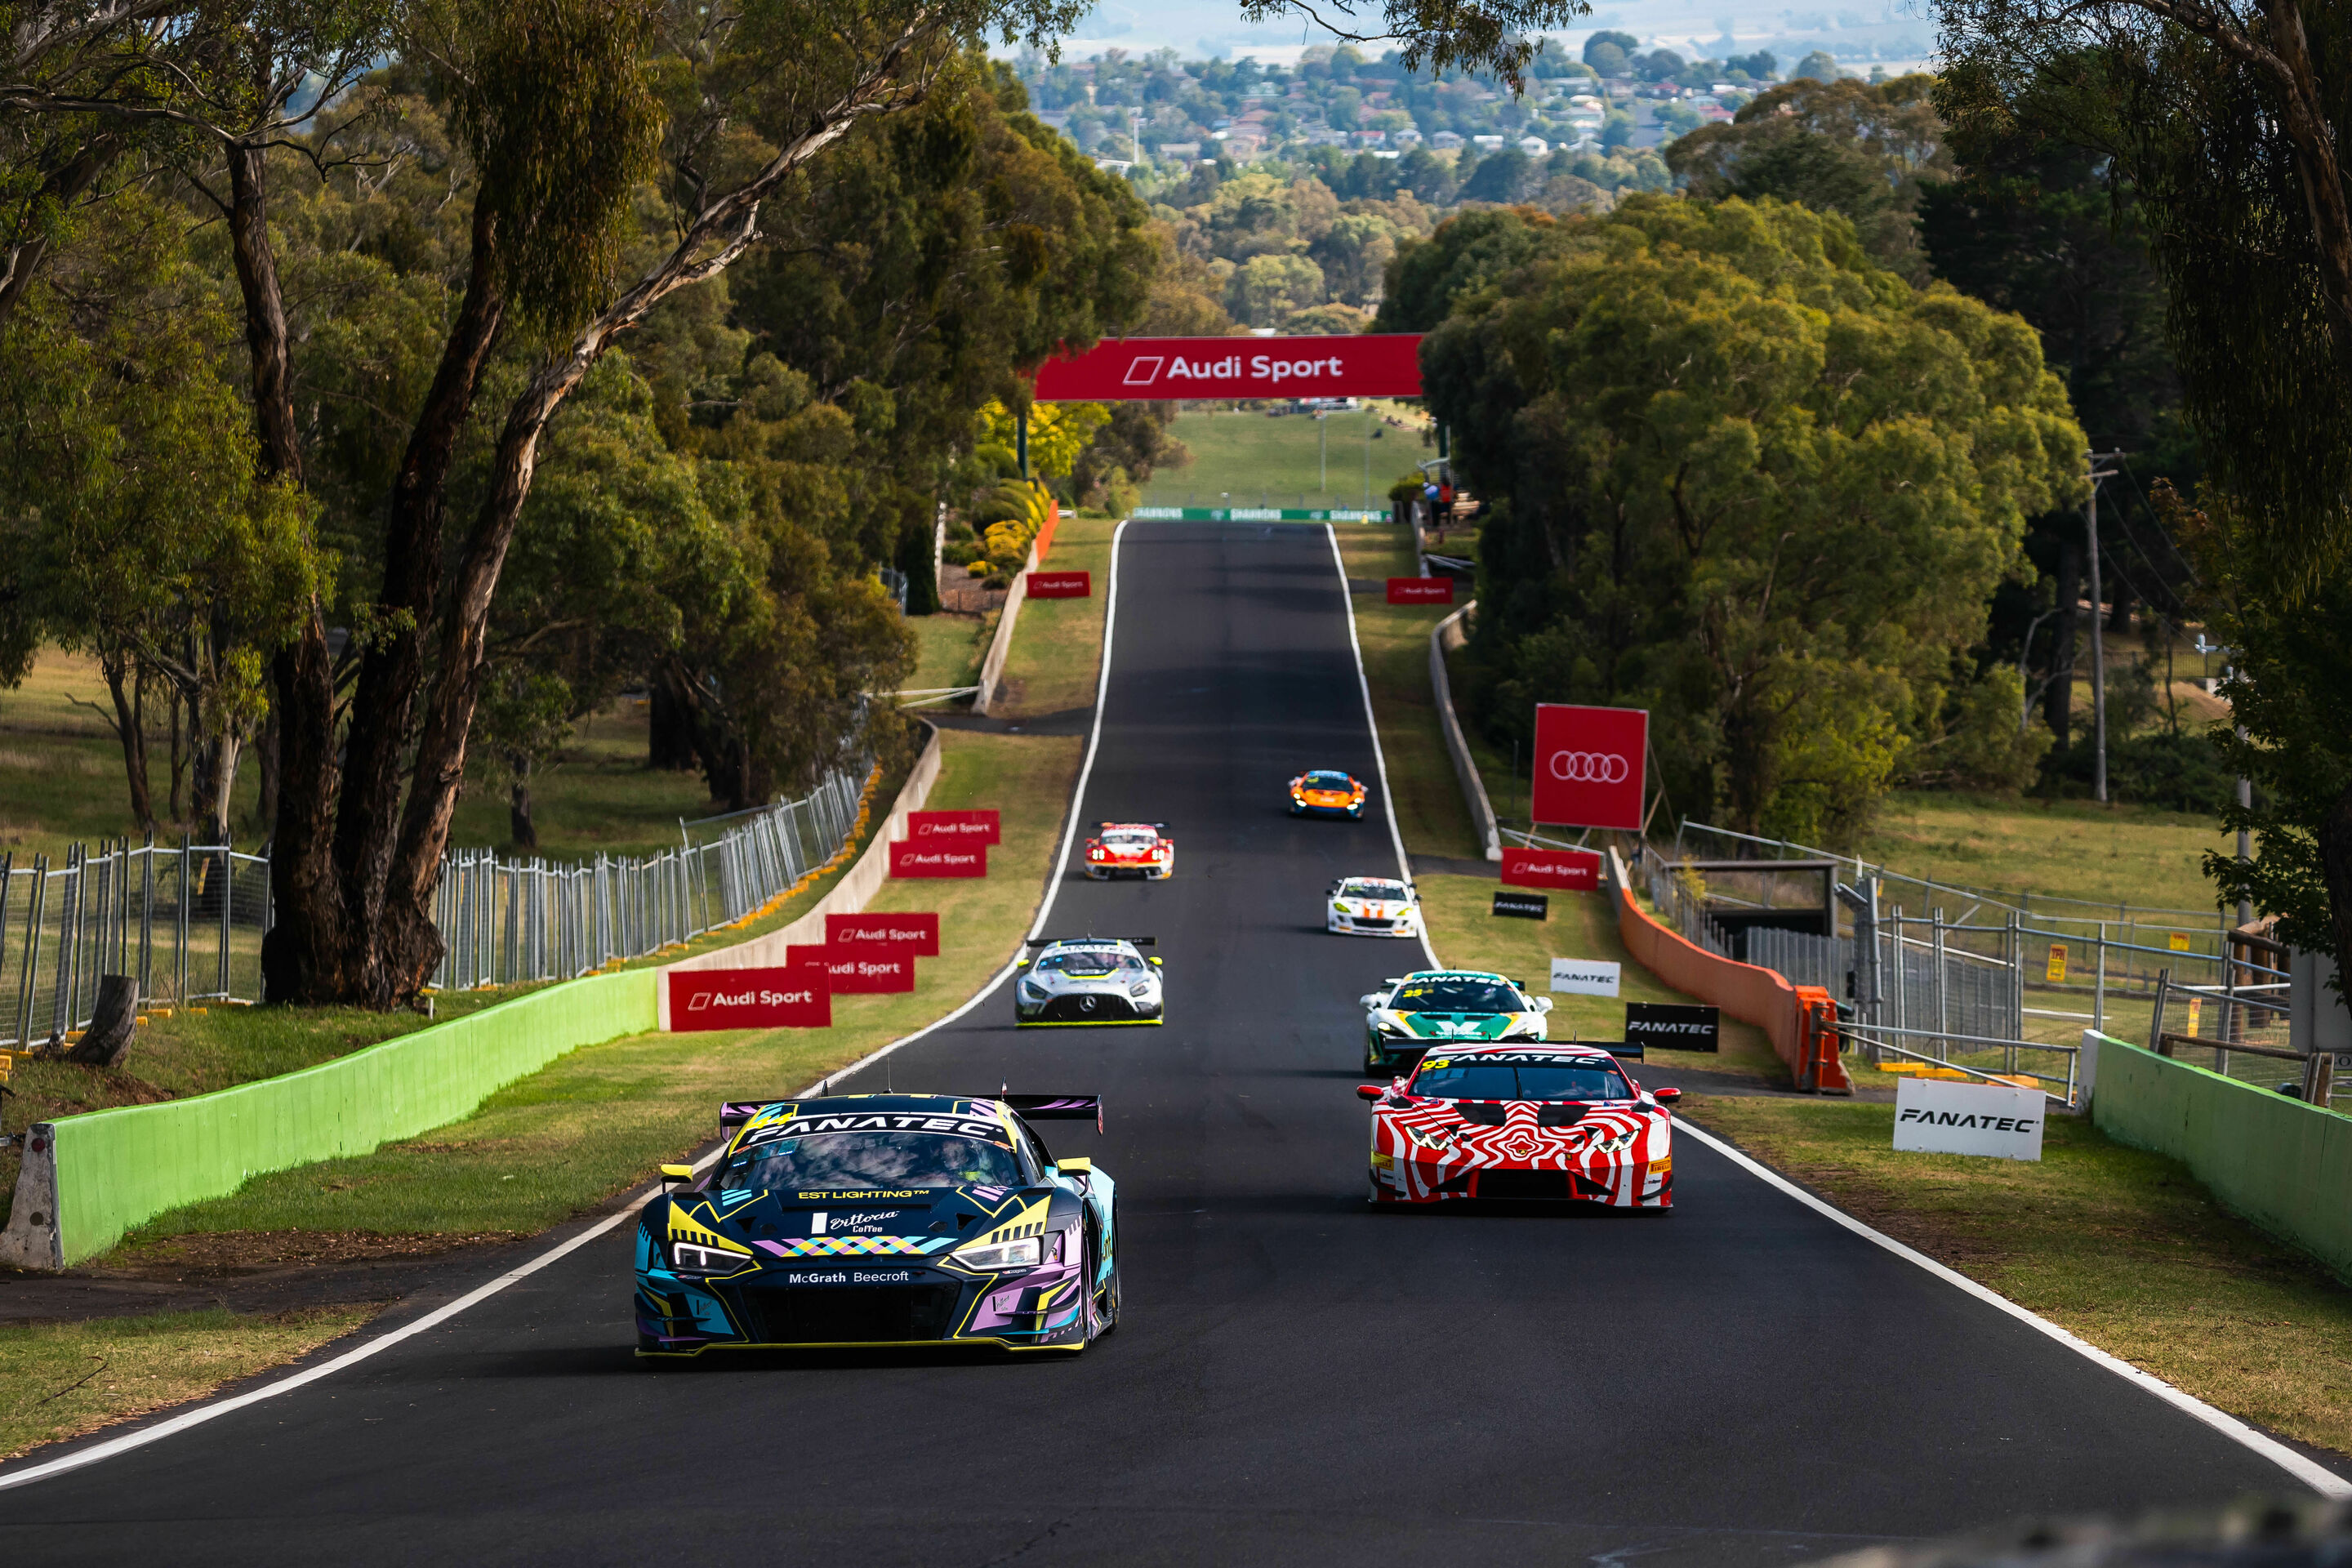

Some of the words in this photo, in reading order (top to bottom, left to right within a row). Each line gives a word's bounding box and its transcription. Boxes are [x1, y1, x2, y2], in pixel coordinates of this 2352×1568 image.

[1166, 356, 1241, 379] Audi
[1250, 355, 1343, 383] Sport
[933, 823, 957, 833] Audi
[959, 822, 990, 835] Sport
[915, 853, 941, 863] Audi
[943, 853, 976, 865] Sport
[1527, 863, 1554, 874] Audi
[1556, 864, 1588, 876] Sport
[1494, 901, 1544, 912] FANATEC
[855, 929, 886, 939] Audi
[889, 929, 927, 942] Sport
[828, 961, 855, 974] udi
[858, 961, 902, 977] Sport
[1553, 972, 1615, 984] FANATEC
[713, 989, 755, 1006] Audi
[760, 990, 813, 1005] Sport
[1628, 1021, 1715, 1035] FANATEC
[1422, 1059, 1450, 1070] 93
[1433, 1054, 1601, 1065] FANATEC
[799, 1192, 830, 1200] EST
[830, 1211, 898, 1230] Vittoria
[853, 1225, 883, 1233] Coffee
[789, 1272, 846, 1284] McGrath
[853, 1271, 909, 1282] Beecroft
